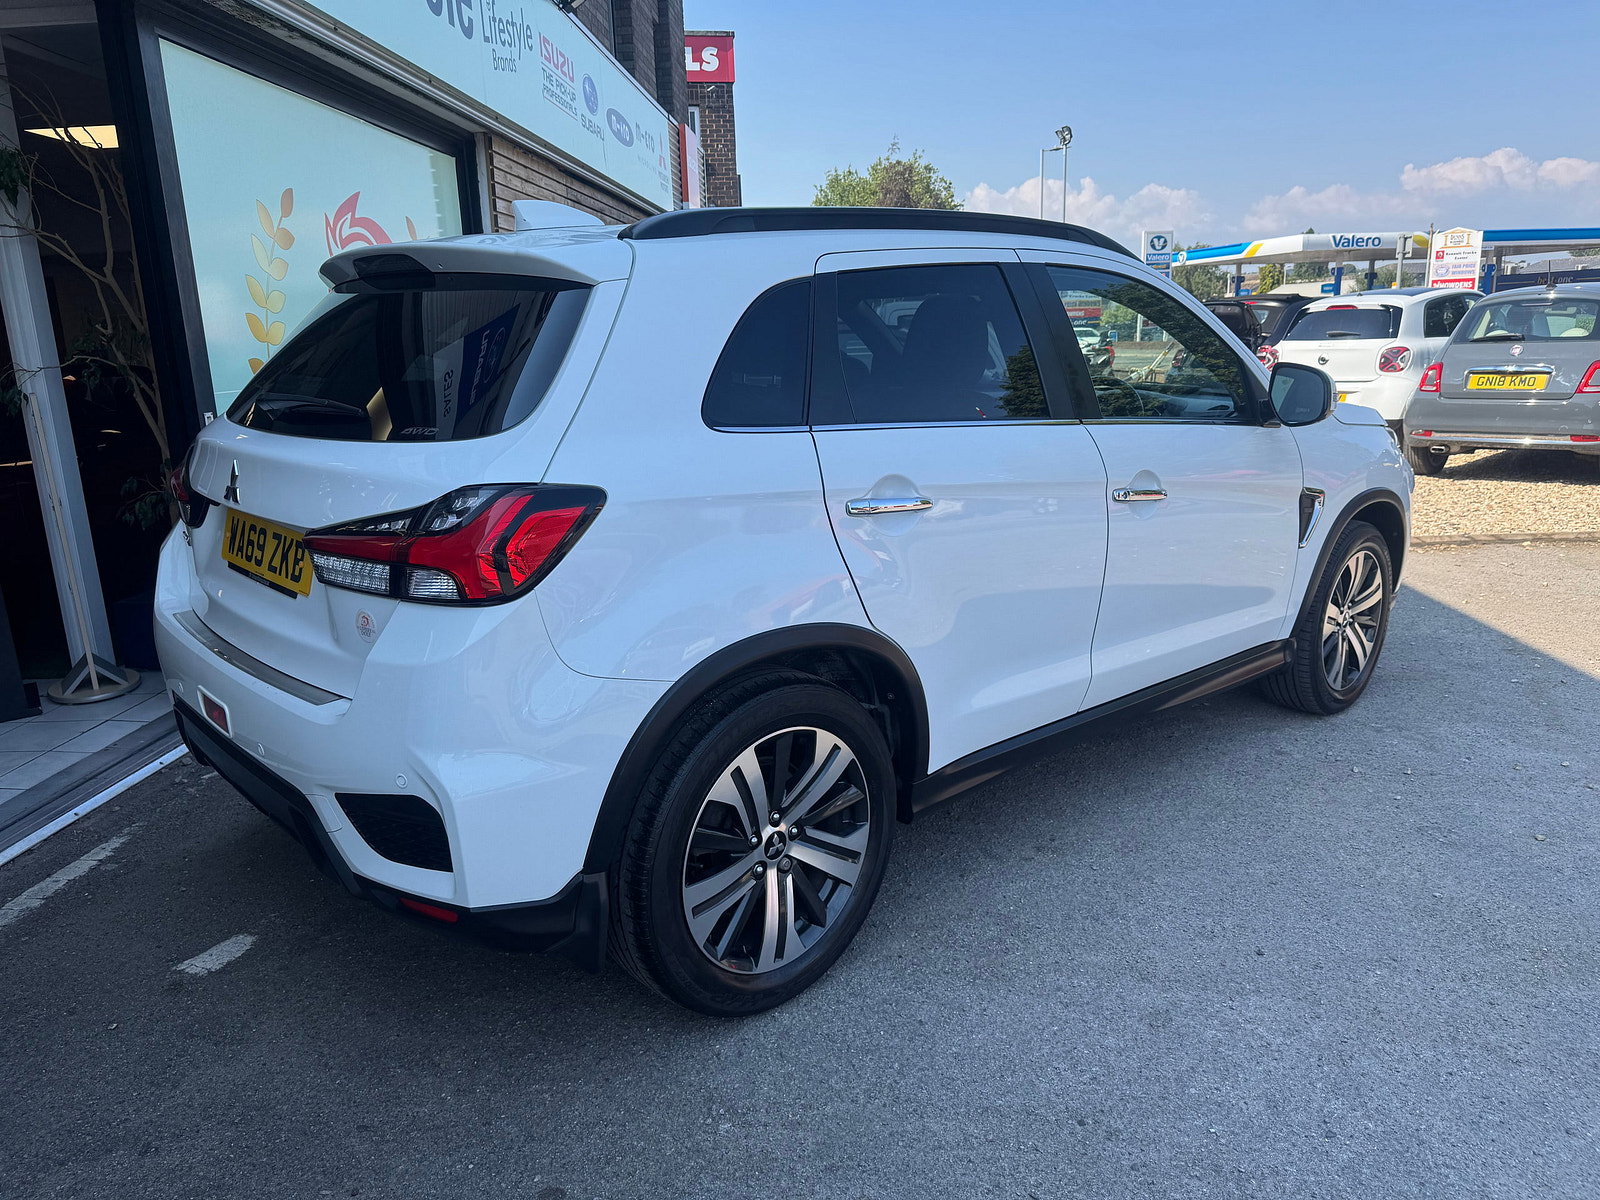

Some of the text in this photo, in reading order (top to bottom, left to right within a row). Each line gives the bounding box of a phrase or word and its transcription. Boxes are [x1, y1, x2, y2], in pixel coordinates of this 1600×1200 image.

[479, 0, 533, 60] Lifestyle
[492, 48, 517, 73] Brands
[539, 32, 575, 83] ISUZU
[541, 67, 577, 102] THE PICK-UP
[543, 83, 578, 116] PROFESSIONALS
[580, 113, 605, 142] SUBARU
[1147, 253, 1170, 261] Valero
[1332, 235, 1381, 248] Valero
[1476, 376, 1537, 387] GN18 KMO
[228, 516, 306, 583] WA69 ZKB
